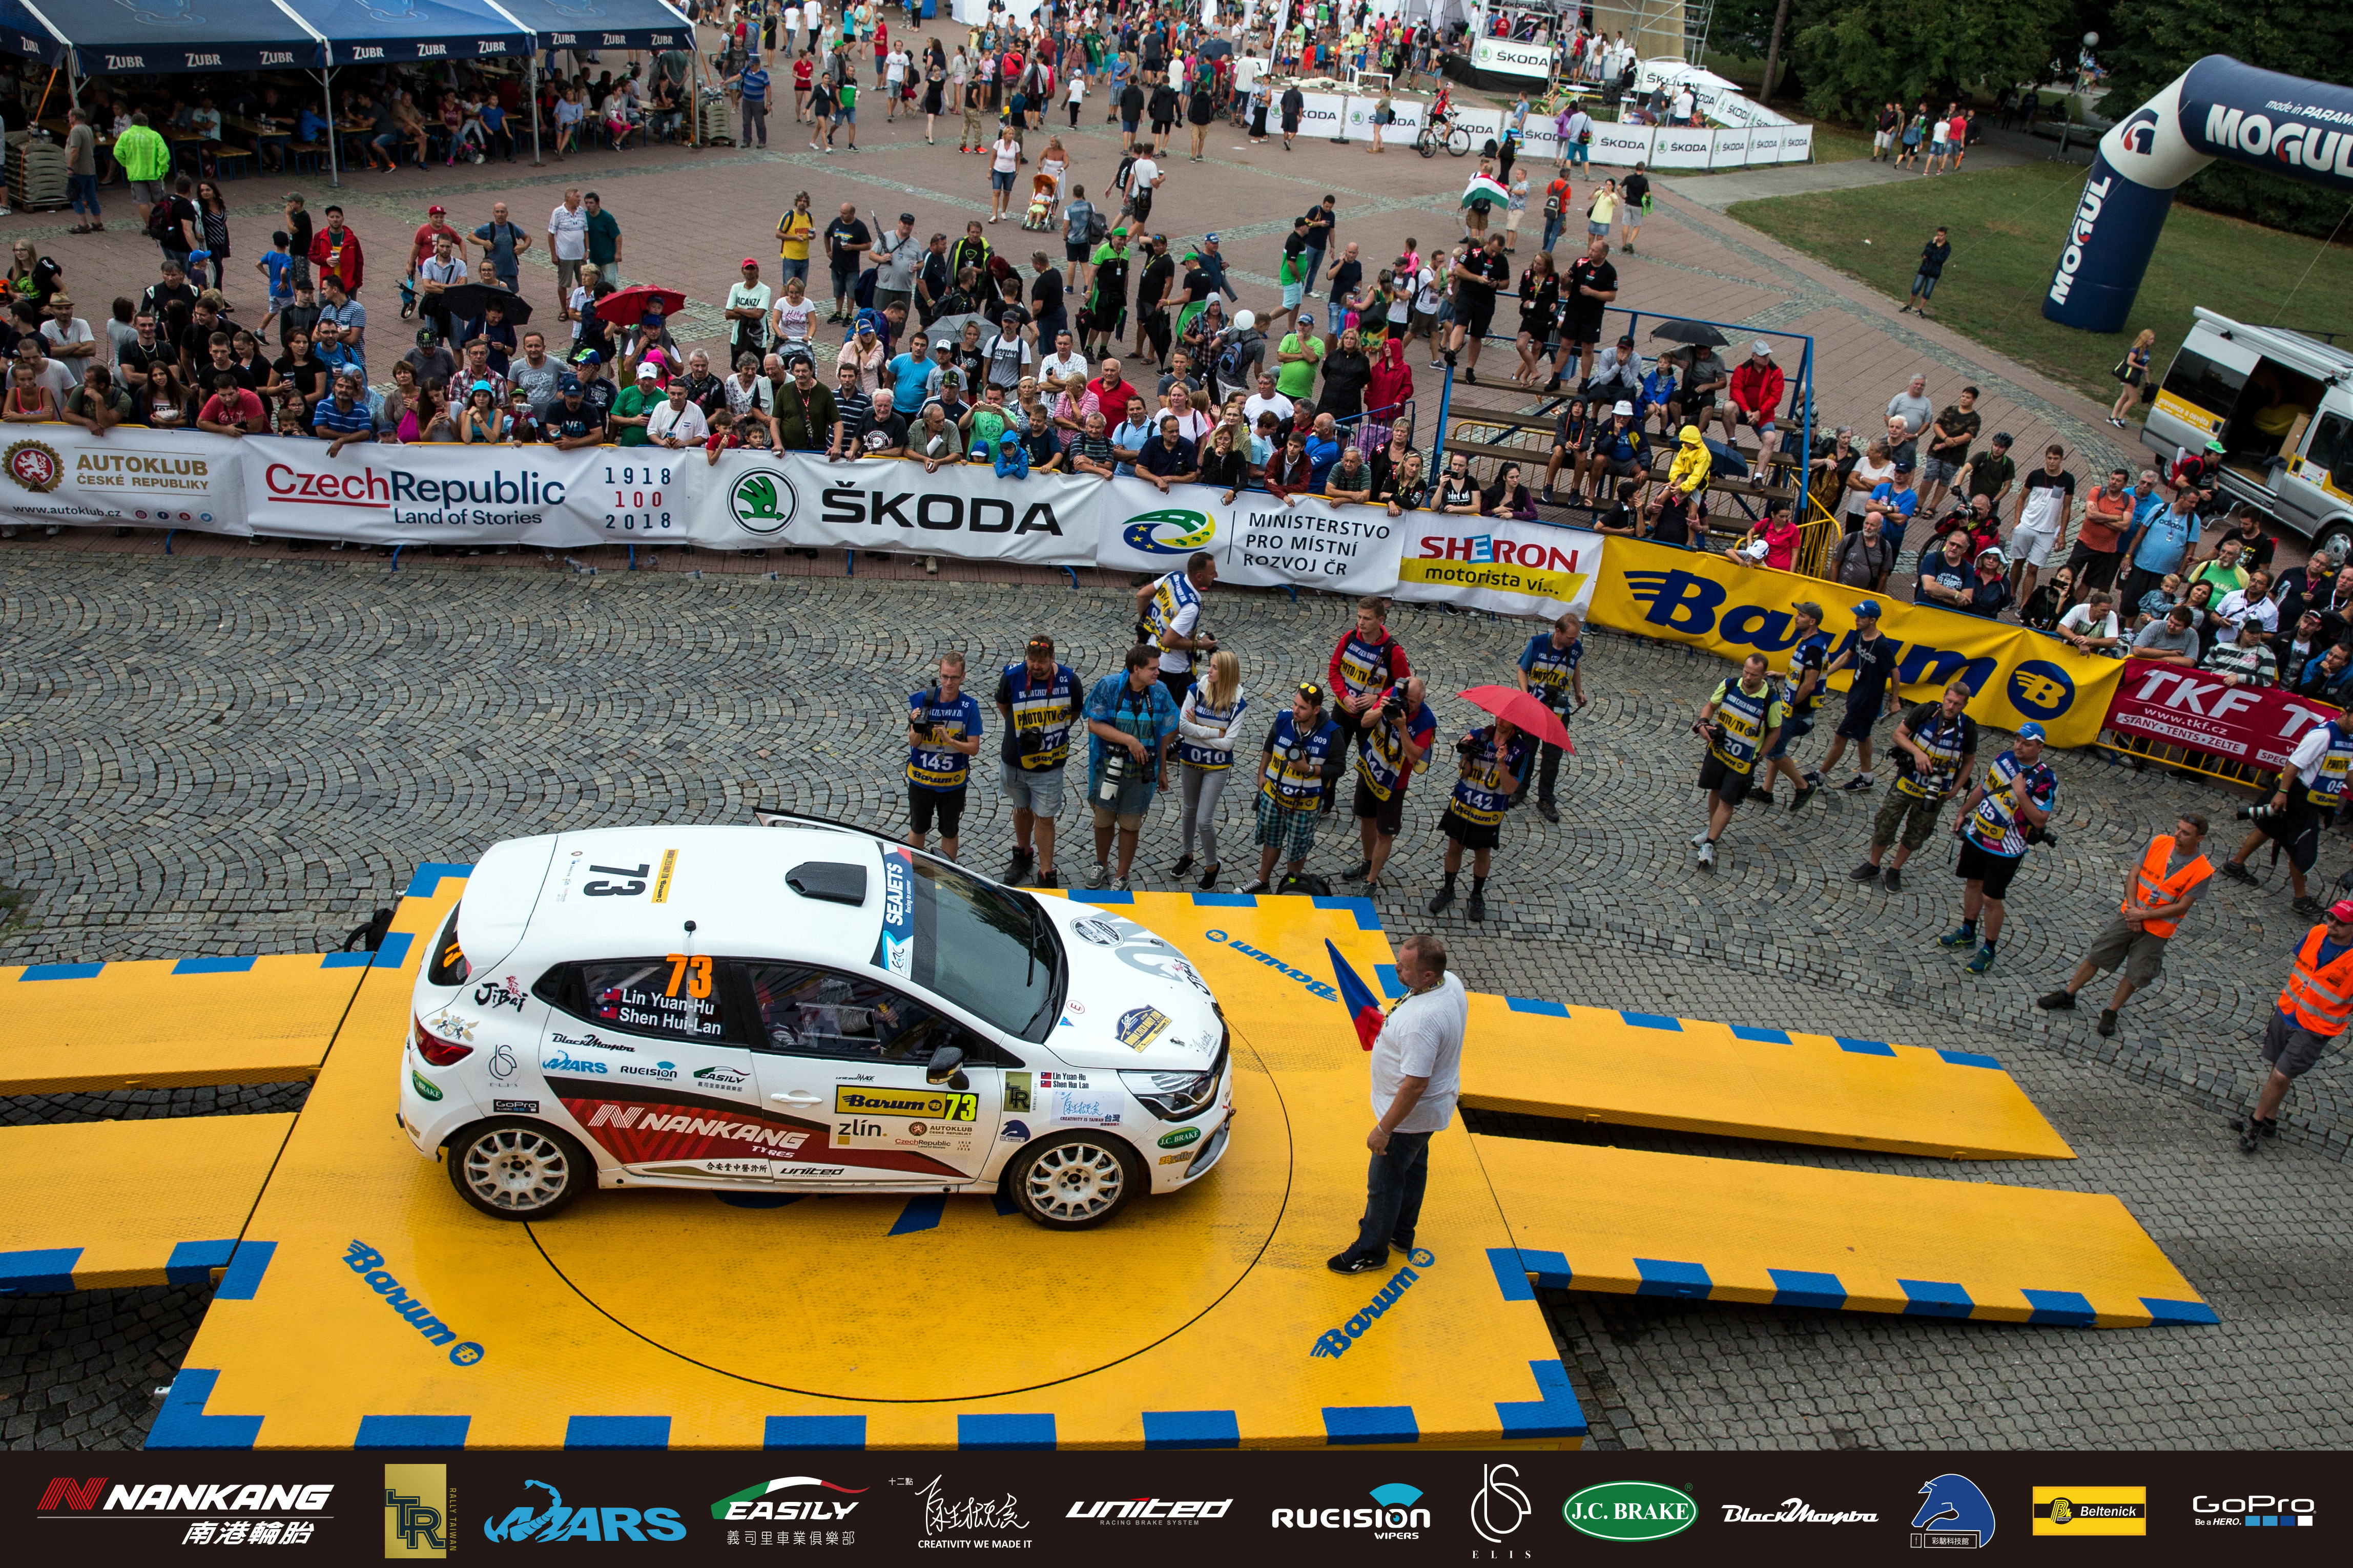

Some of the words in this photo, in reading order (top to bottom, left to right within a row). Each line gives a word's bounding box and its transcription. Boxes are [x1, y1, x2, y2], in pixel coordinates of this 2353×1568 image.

[478, 40, 506, 53] ZUBR
[551, 33, 576, 45] ZUBR
[603, 33, 626, 45] ZUBR
[651, 34, 673, 45] ZUBR
[259, 51, 294, 65] ZUBR
[353, 47, 384, 60] ZUBR
[417, 44, 447, 57] ZUBR
[1497, 50, 1549, 67] ŠKODA
[106, 54, 145, 70] ZUBR
[185, 53, 222, 67] ZUBR
[1303, 110, 1336, 120] KODA
[2265, 100, 2293, 114] made
[2290, 104, 2303, 114] in
[2300, 106, 2353, 126] PARAM
[1525, 130, 1558, 141] ŠKOD
[1601, 137, 1645, 150] ŠKODA
[1757, 140, 1777, 148] ŠKODA
[1788, 138, 1807, 147] ŠKODA
[2205, 103, 2353, 178] MOGUL
[1670, 142, 1707, 152] ŠKODA
[1722, 142, 1744, 151] ŠKODA
[2050, 176, 2112, 305] MOGUL
[76, 454, 208, 476] AUTOKLUB
[77, 472, 125, 486] ČESKÉ
[132, 477, 209, 490] REPUBLIKY
[605, 467, 671, 485] 1918
[615, 490, 662, 508] 100
[12, 505, 122, 517] www.autoklub.cz
[395, 507, 443, 524] Land
[448, 509, 468, 525] of
[472, 510, 542, 525] Stories
[821, 480, 1063, 536] ŠKODA
[606, 513, 671, 530] 2018
[1249, 512, 1390, 539] MINISTERSTVO
[1246, 534, 1283, 549] PRO
[1291, 534, 1358, 557] MÍSTNÍ
[1419, 534, 1578, 573] SHERON
[1244, 553, 1316, 573] ROZVOJ
[1324, 559, 1346, 576] ČR
[1426, 567, 1519, 588] motorista
[1527, 578, 1559, 595] ví...
[2136, 670, 2262, 718] TKF
[2144, 707, 2228, 736] www.tkf.cz
[1313, 736, 1327, 745] 009
[2122, 715, 2158, 732] STANY
[2166, 725, 2200, 741] TENTS
[2208, 736, 2240, 752] ZELTE
[920, 753, 953, 770] 145
[1190, 748, 1226, 763] 010
[1464, 790, 1493, 810] 142
[584, 864, 650, 896] 73
[886, 863, 903, 926] SEAJETS
[665, 953, 712, 998] 73
[1228, 940, 1337, 1002] Barum
[622, 988, 646, 1005] Lin
[651, 992, 714, 1015] Yuan-Hu
[620, 1007, 657, 1027] Shen
[663, 1009, 721, 1036] Hui-Lan
[542, 1053, 608, 1074] MARS
[698, 1072, 745, 1084] EASILY
[1052, 1080, 1067, 1089] Shen
[1079, 1081, 1089, 1090] Lan
[1062, 1073, 1086, 1081] Yuan-Hu
[418, 1080, 441, 1099] BRAKE
[842, 1094, 925, 1111] Barum
[945, 1094, 977, 1121] 73
[1104, 1114, 1120, 1123] 台灣
[637, 1113, 810, 1149] NANKANG
[1160, 1138, 1173, 1146] J.C.
[1174, 1130, 1199, 1142] BRAKE
[752, 1145, 795, 1158] TYRES
[780, 1167, 844, 1176] united
[342, 1239, 457, 1347] Barum
[1310, 1266, 1420, 1359] Barum
